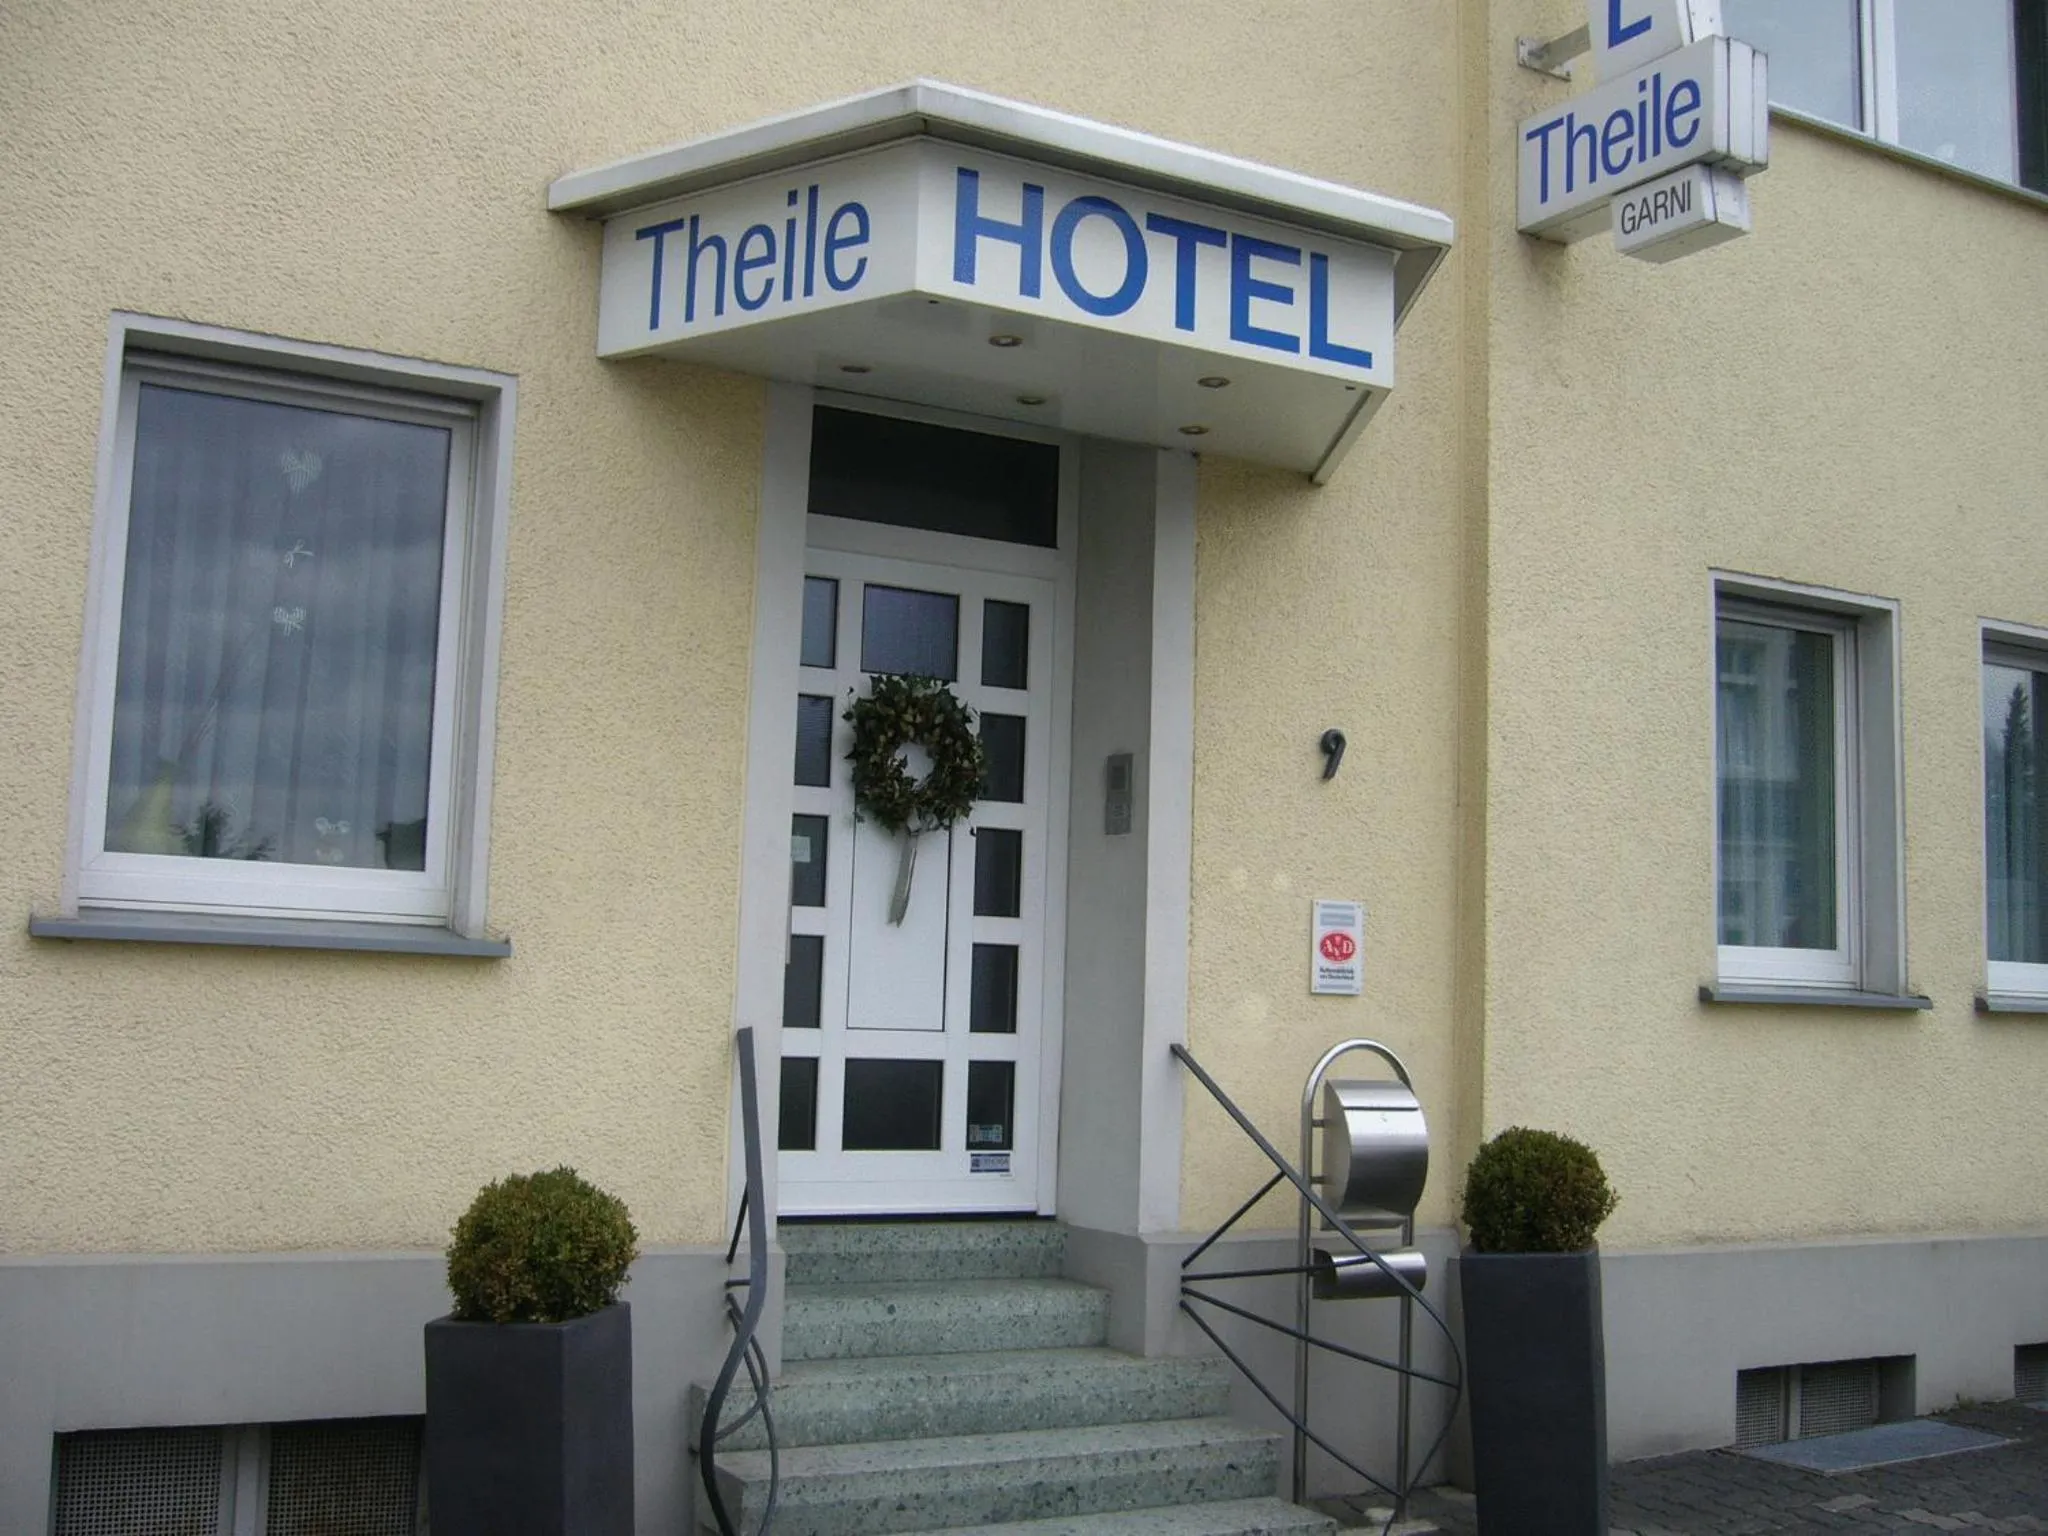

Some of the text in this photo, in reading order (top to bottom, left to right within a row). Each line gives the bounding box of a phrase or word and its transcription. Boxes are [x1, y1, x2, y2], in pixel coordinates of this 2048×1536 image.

[1526, 72, 1701, 204] Theile
[635, 184, 871, 332] Theile
[952, 166, 1373, 370] HOTEL
[1620, 180, 1692, 235] GARNI
[1320, 728, 1347, 781] 9
